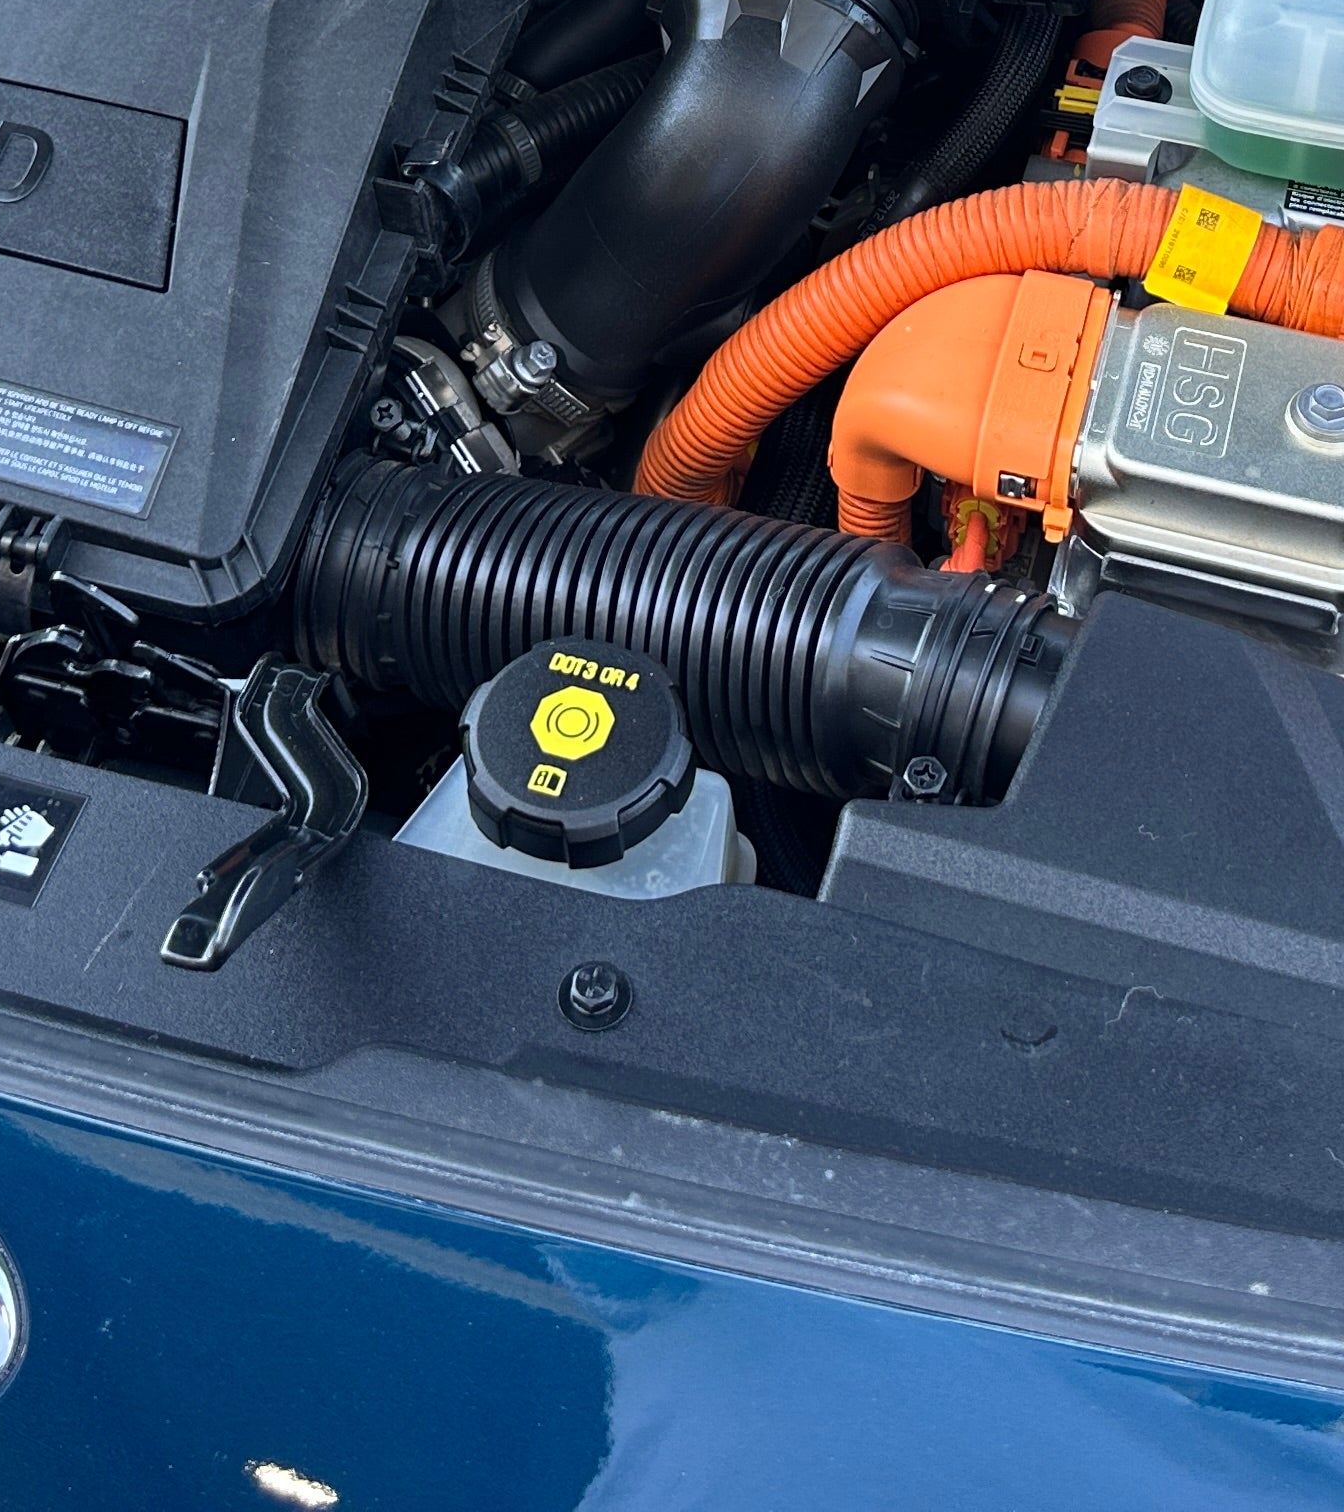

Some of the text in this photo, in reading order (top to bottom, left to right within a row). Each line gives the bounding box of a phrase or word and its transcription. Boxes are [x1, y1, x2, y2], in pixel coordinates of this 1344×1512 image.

[1164, 338, 1236, 446] HSG
[76, 409, 97, 419] READY
[98, 414, 118, 424] LAMP
[124, 422, 138, 430] OFF
[599, 666, 626, 688] OR
[624, 672, 641, 692] 4
